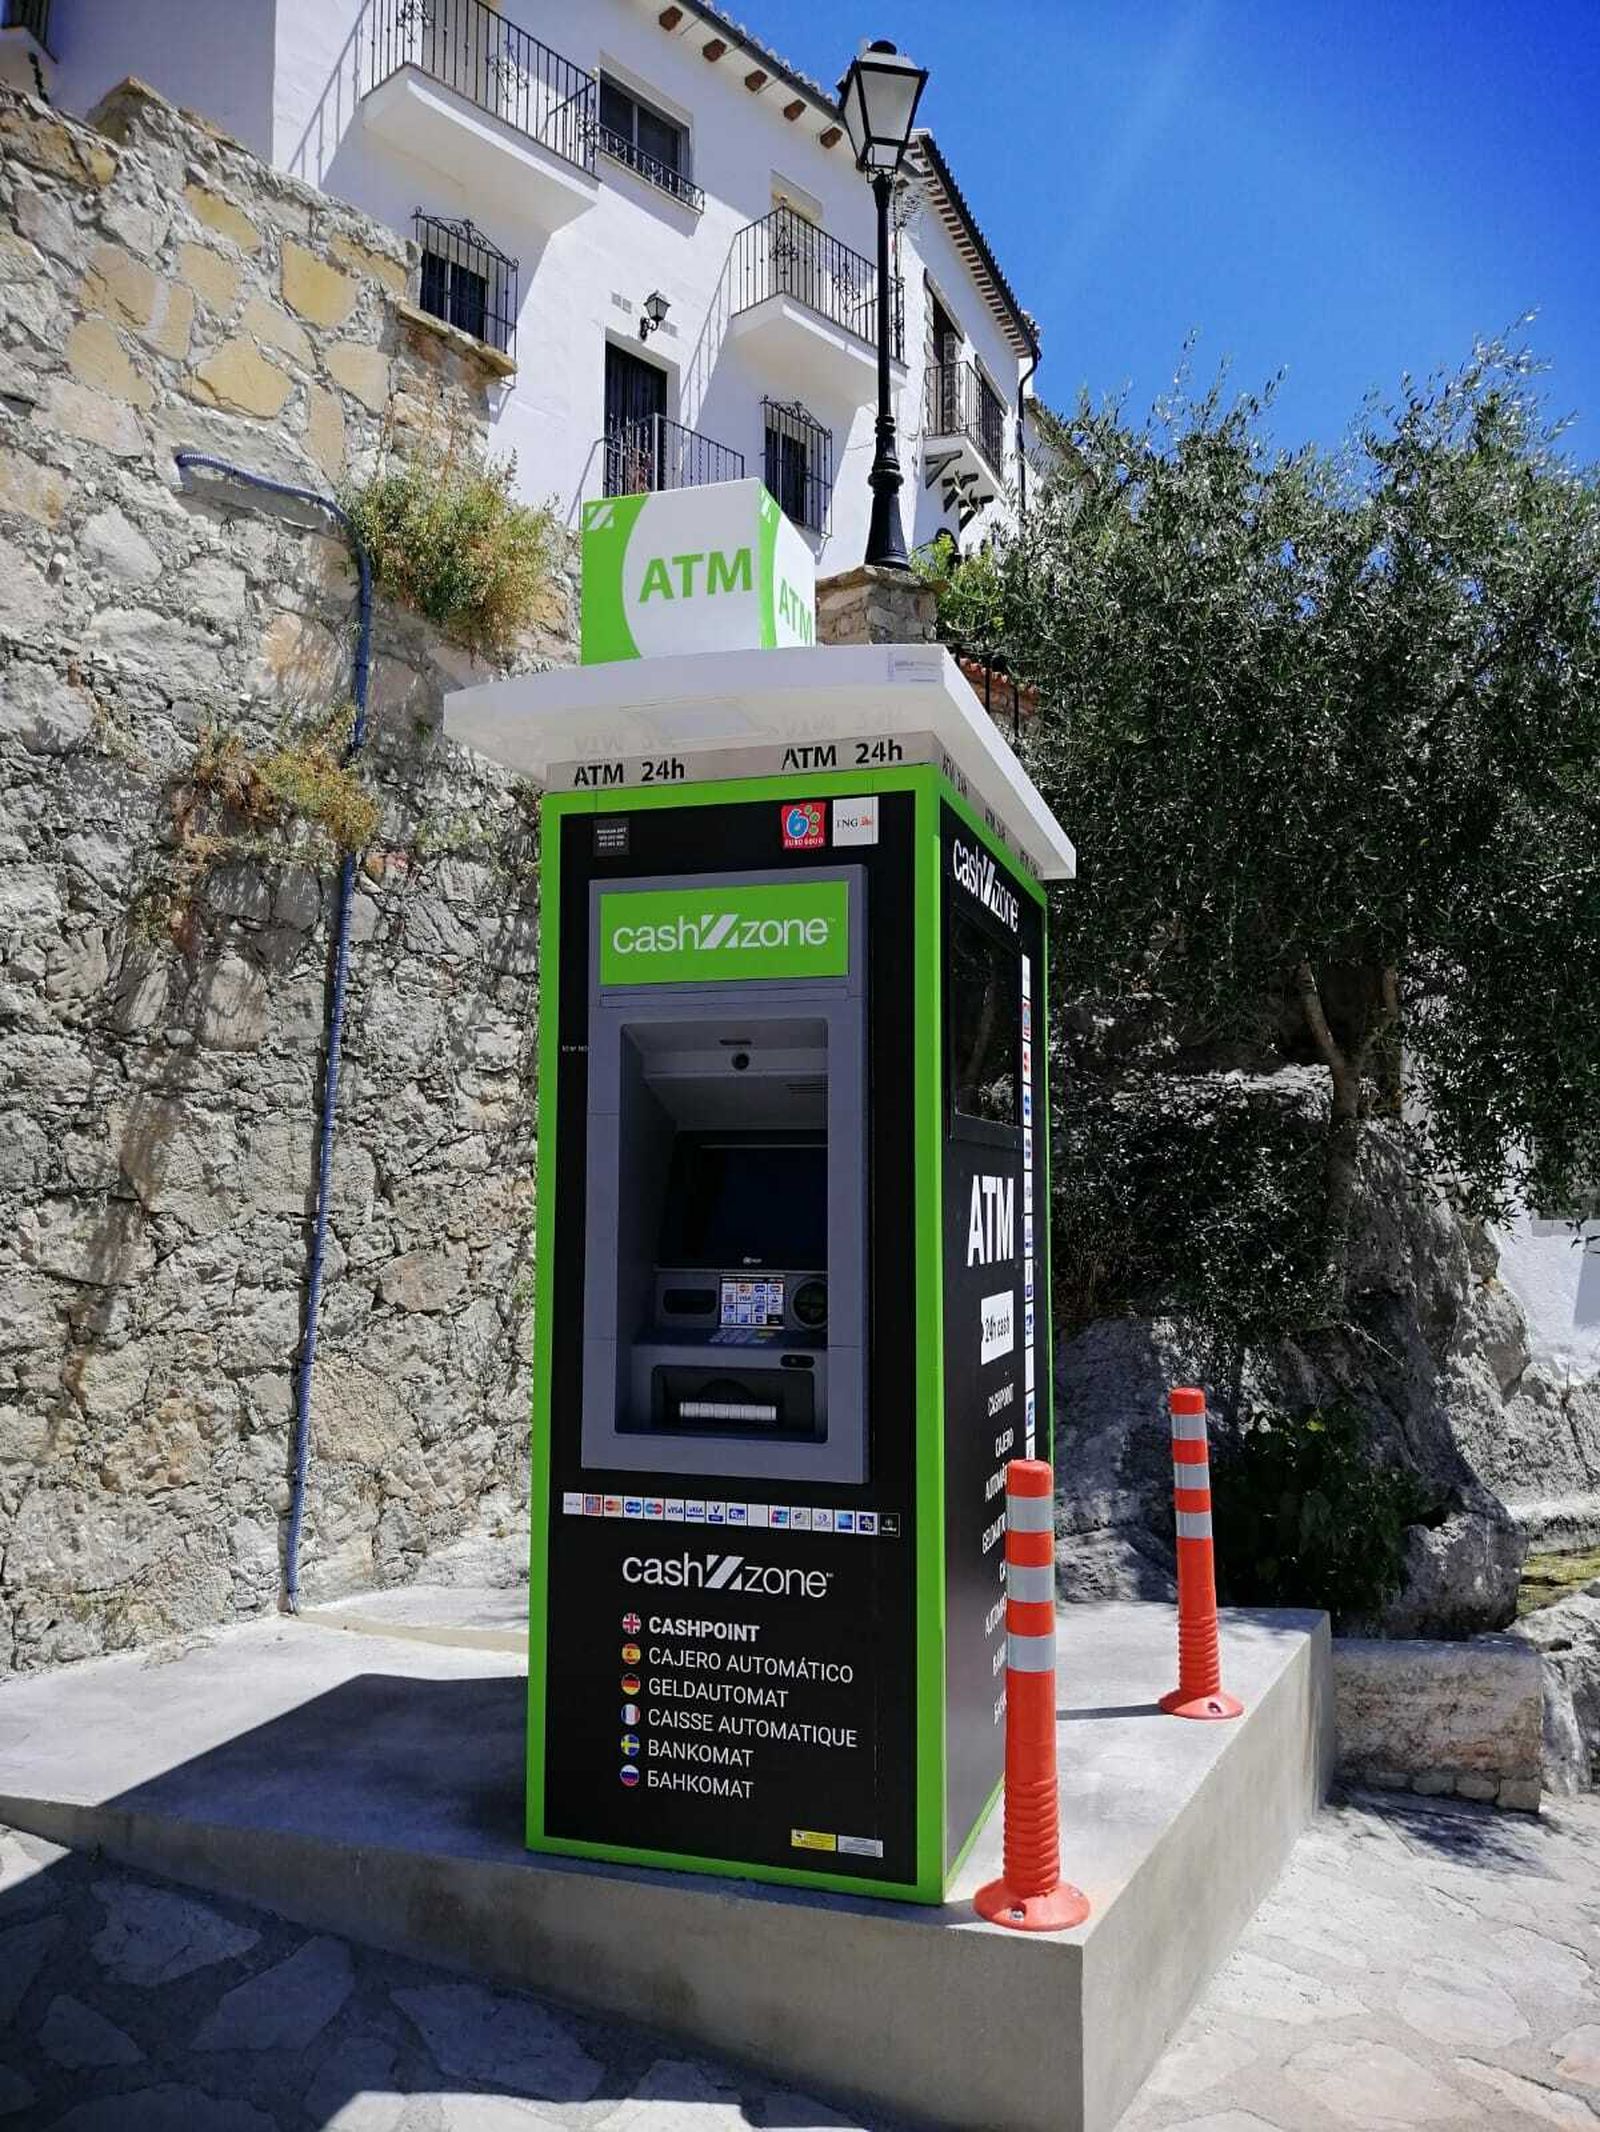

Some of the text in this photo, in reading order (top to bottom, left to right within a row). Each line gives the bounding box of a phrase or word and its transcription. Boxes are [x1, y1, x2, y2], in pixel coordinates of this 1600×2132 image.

[638, 547, 753, 603] ATM
[779, 577, 812, 646] ATM
[574, 758, 685, 787] ATM 24h
[781, 739, 903, 770] ATM 24h
[836, 818, 858, 829] ING
[953, 838, 985, 900] cash
[612, 915, 829, 954] cash zone
[967, 1174, 1014, 1267] ATM
[622, 1553, 828, 1598] cash zone
[648, 1616, 760, 1642] CASHPOINT
[648, 1647, 853, 1684] CAJERO AUTOMÁTICO
[648, 1677, 789, 1708] GELDAUTOMAT
[648, 1708, 858, 1749] CAISSE AUTOMATIQUE
[648, 1739, 754, 1768] BANKOMAT
[647, 1770, 754, 1799] БАНКОМАТ
